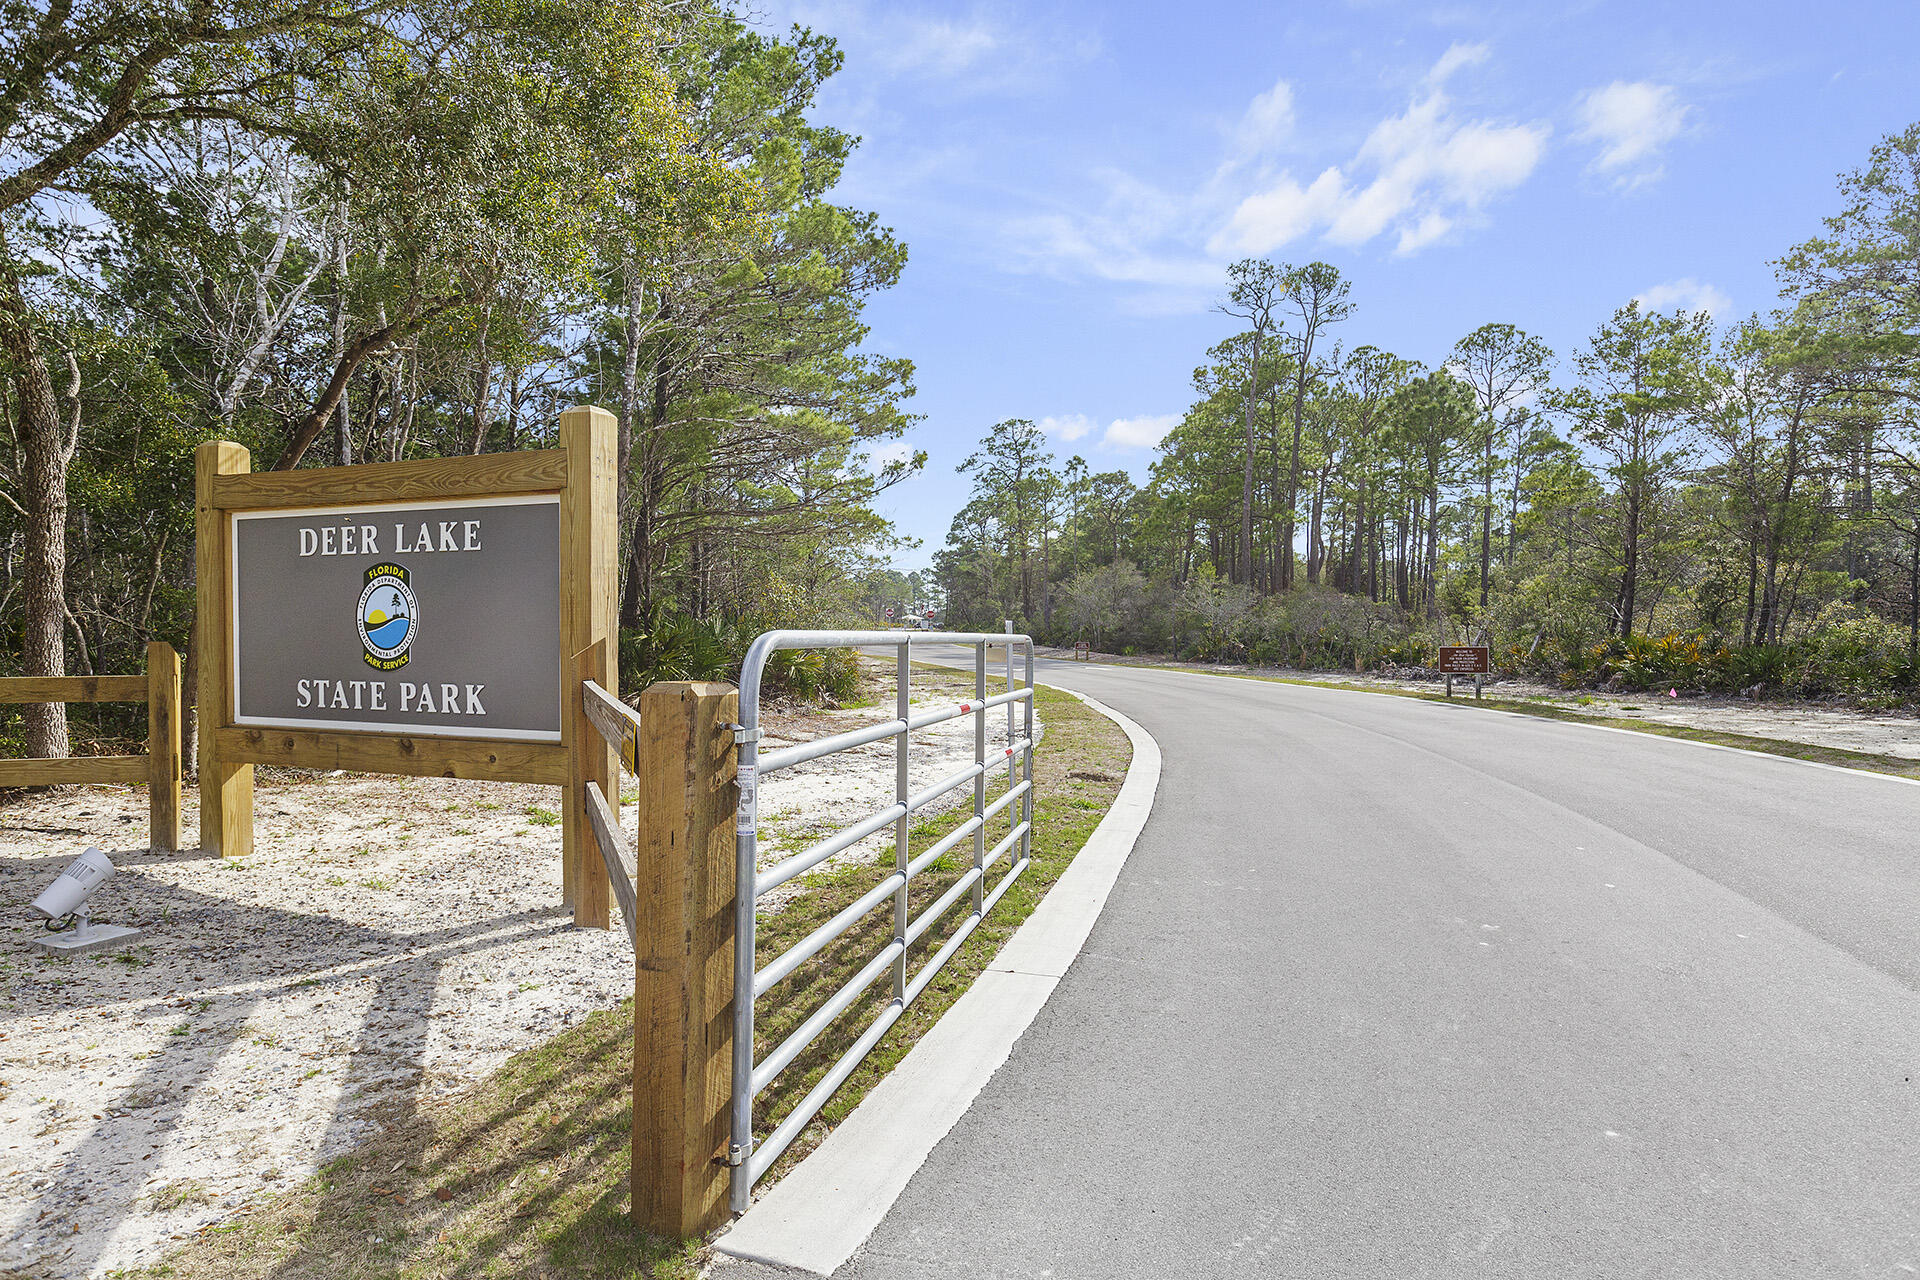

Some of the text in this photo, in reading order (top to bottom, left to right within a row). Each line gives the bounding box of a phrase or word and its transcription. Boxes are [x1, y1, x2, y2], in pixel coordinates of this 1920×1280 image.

[299, 520, 482, 557] DEER LAKE
[368, 565, 404, 579] FLORIDA
[359, 577, 415, 609] FLORIDA DEPARTMENT OF
[358, 618, 416, 657] ENVIRONMENTAL PROTECTION
[364, 653, 409, 670] PARK SERVICE
[296, 678, 487, 715] STATE PARK
